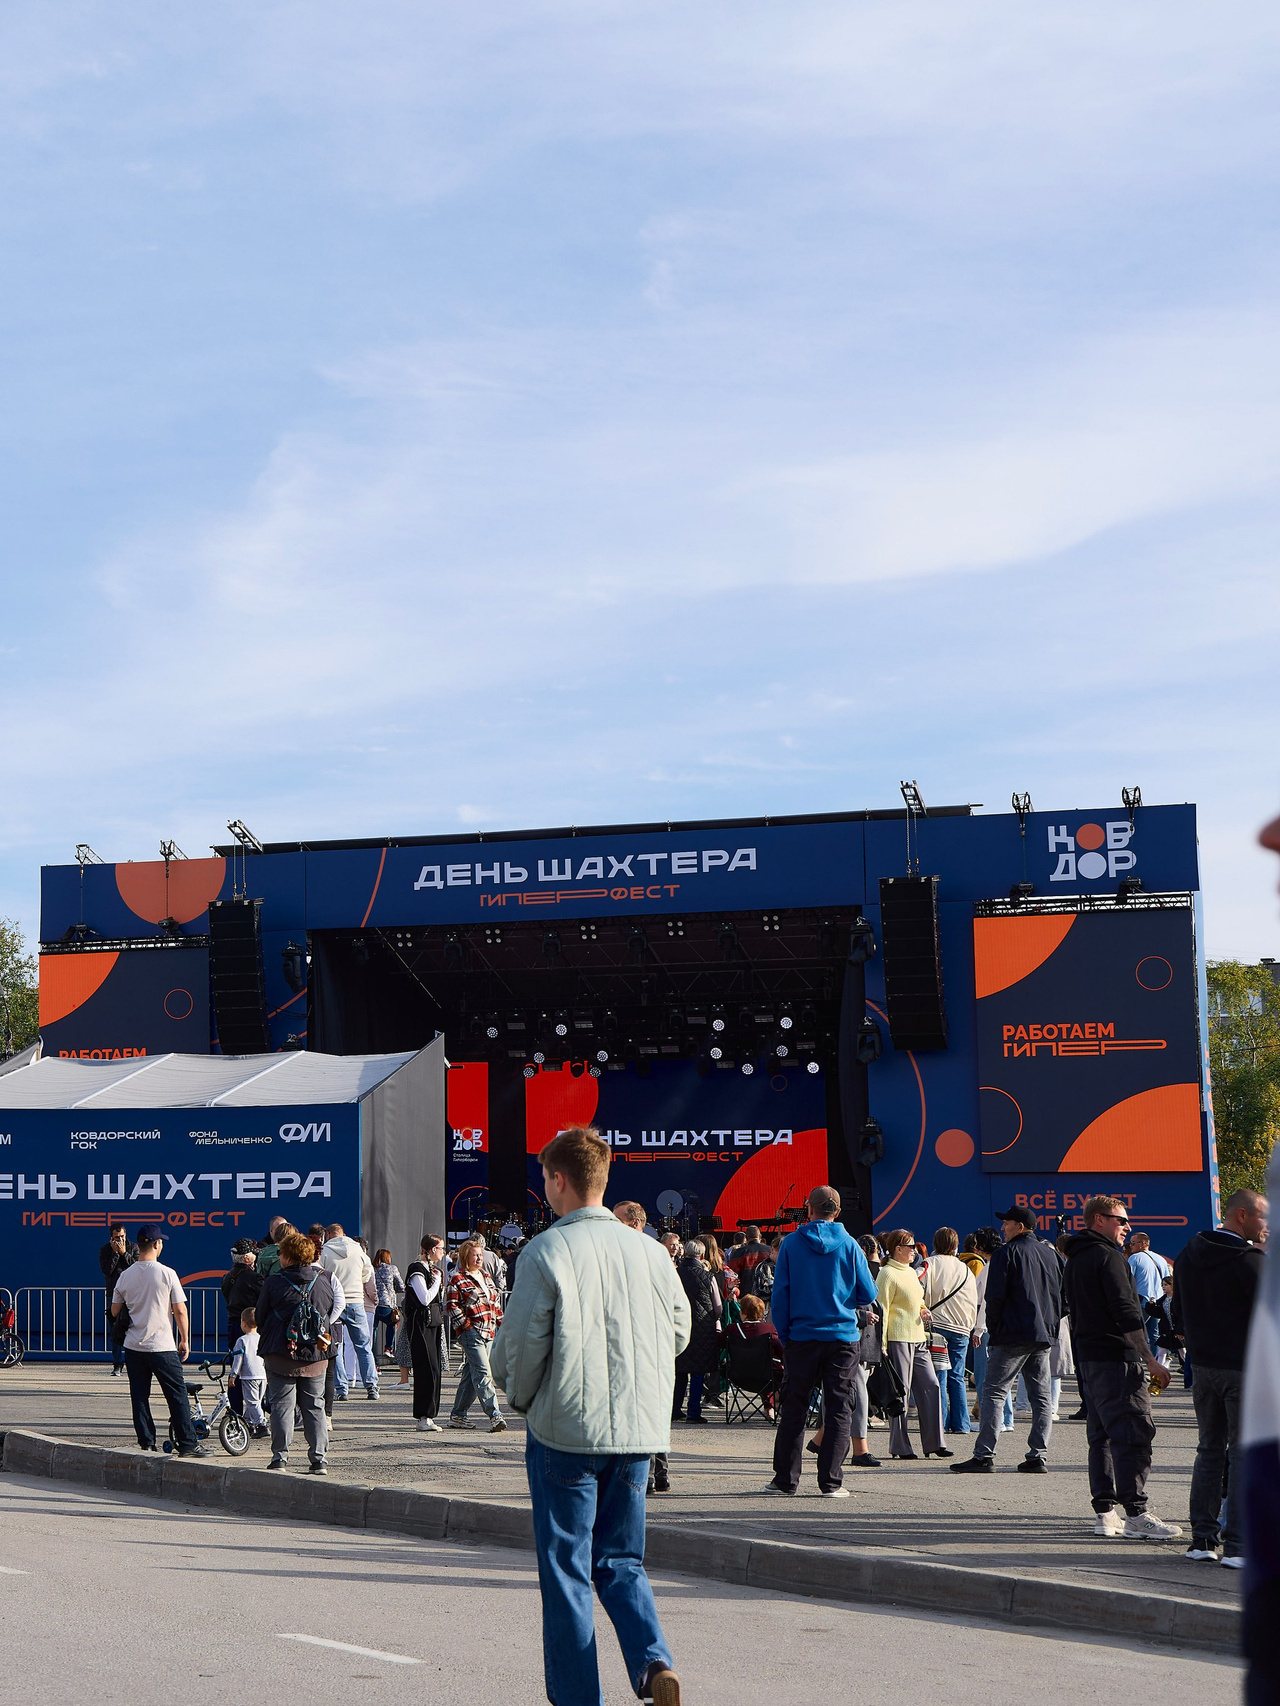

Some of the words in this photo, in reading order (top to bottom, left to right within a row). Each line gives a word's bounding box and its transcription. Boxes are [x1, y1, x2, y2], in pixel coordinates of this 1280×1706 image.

[414, 861, 529, 890] ДЕНЬ
[537, 848, 757, 882] ШАХТЕРА
[1002, 1022, 1115, 1041] РАБОТАЕМ
[1003, 1039, 1167, 1058] ГИПЕР
[70, 1129, 161, 1140] КОВДОРСКИЙ
[195, 1137, 272, 1145] МЕЛЬНИЧЕНКО
[641, 1129, 793, 1146] ШАХТЕРА
[70, 1141, 97, 1149] ГОК
[87, 1171, 331, 1200] ШАХТЕРА
[1015, 1190, 1057, 1209] ВСЁ
[22, 1211, 246, 1227] ГИПЕРФЕСТ
